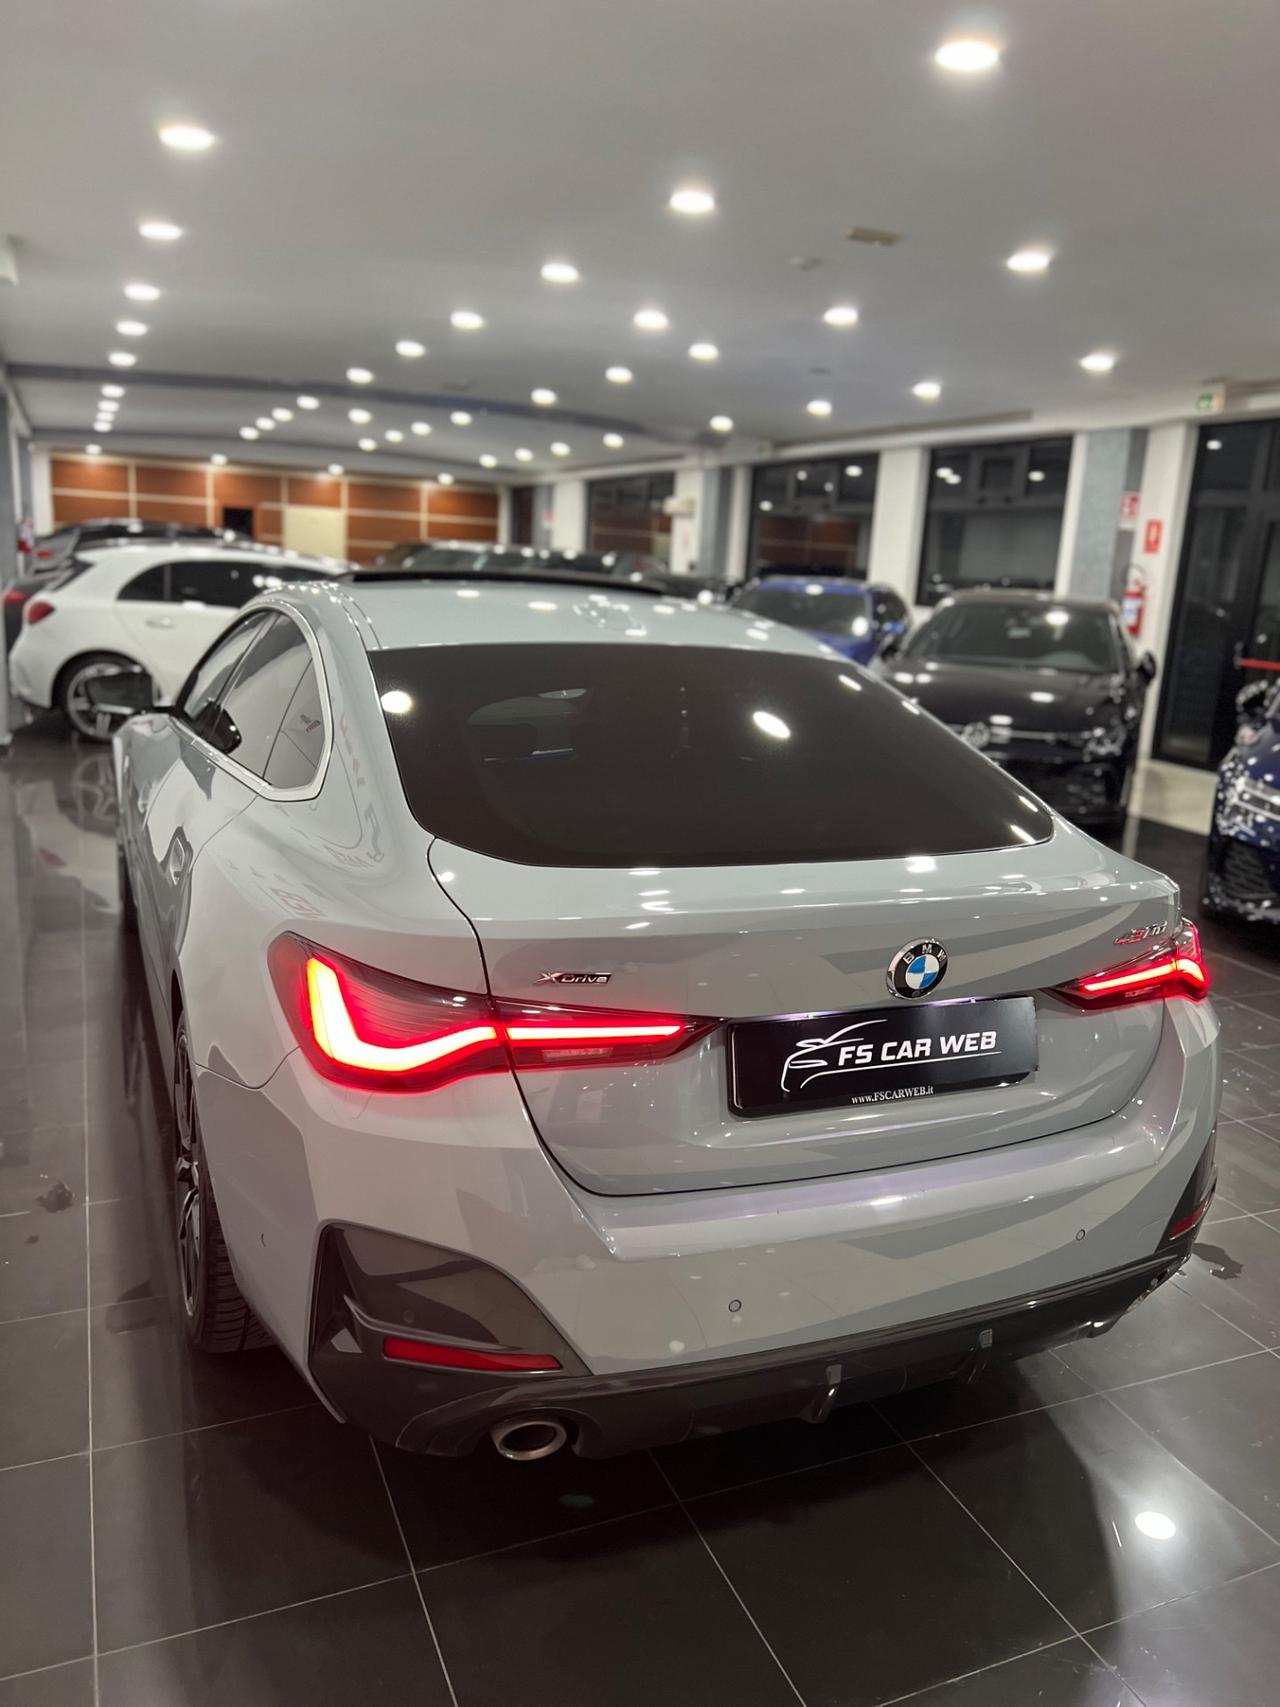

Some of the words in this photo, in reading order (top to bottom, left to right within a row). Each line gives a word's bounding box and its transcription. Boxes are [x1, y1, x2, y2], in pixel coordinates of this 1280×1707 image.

[902, 943, 947, 965] BMW
[838, 1043, 874, 1066] FS
[880, 1038, 932, 1062] CAR
[939, 1030, 997, 1054] WEB
[851, 1085, 934, 1104] www.FSCARWEB.it
